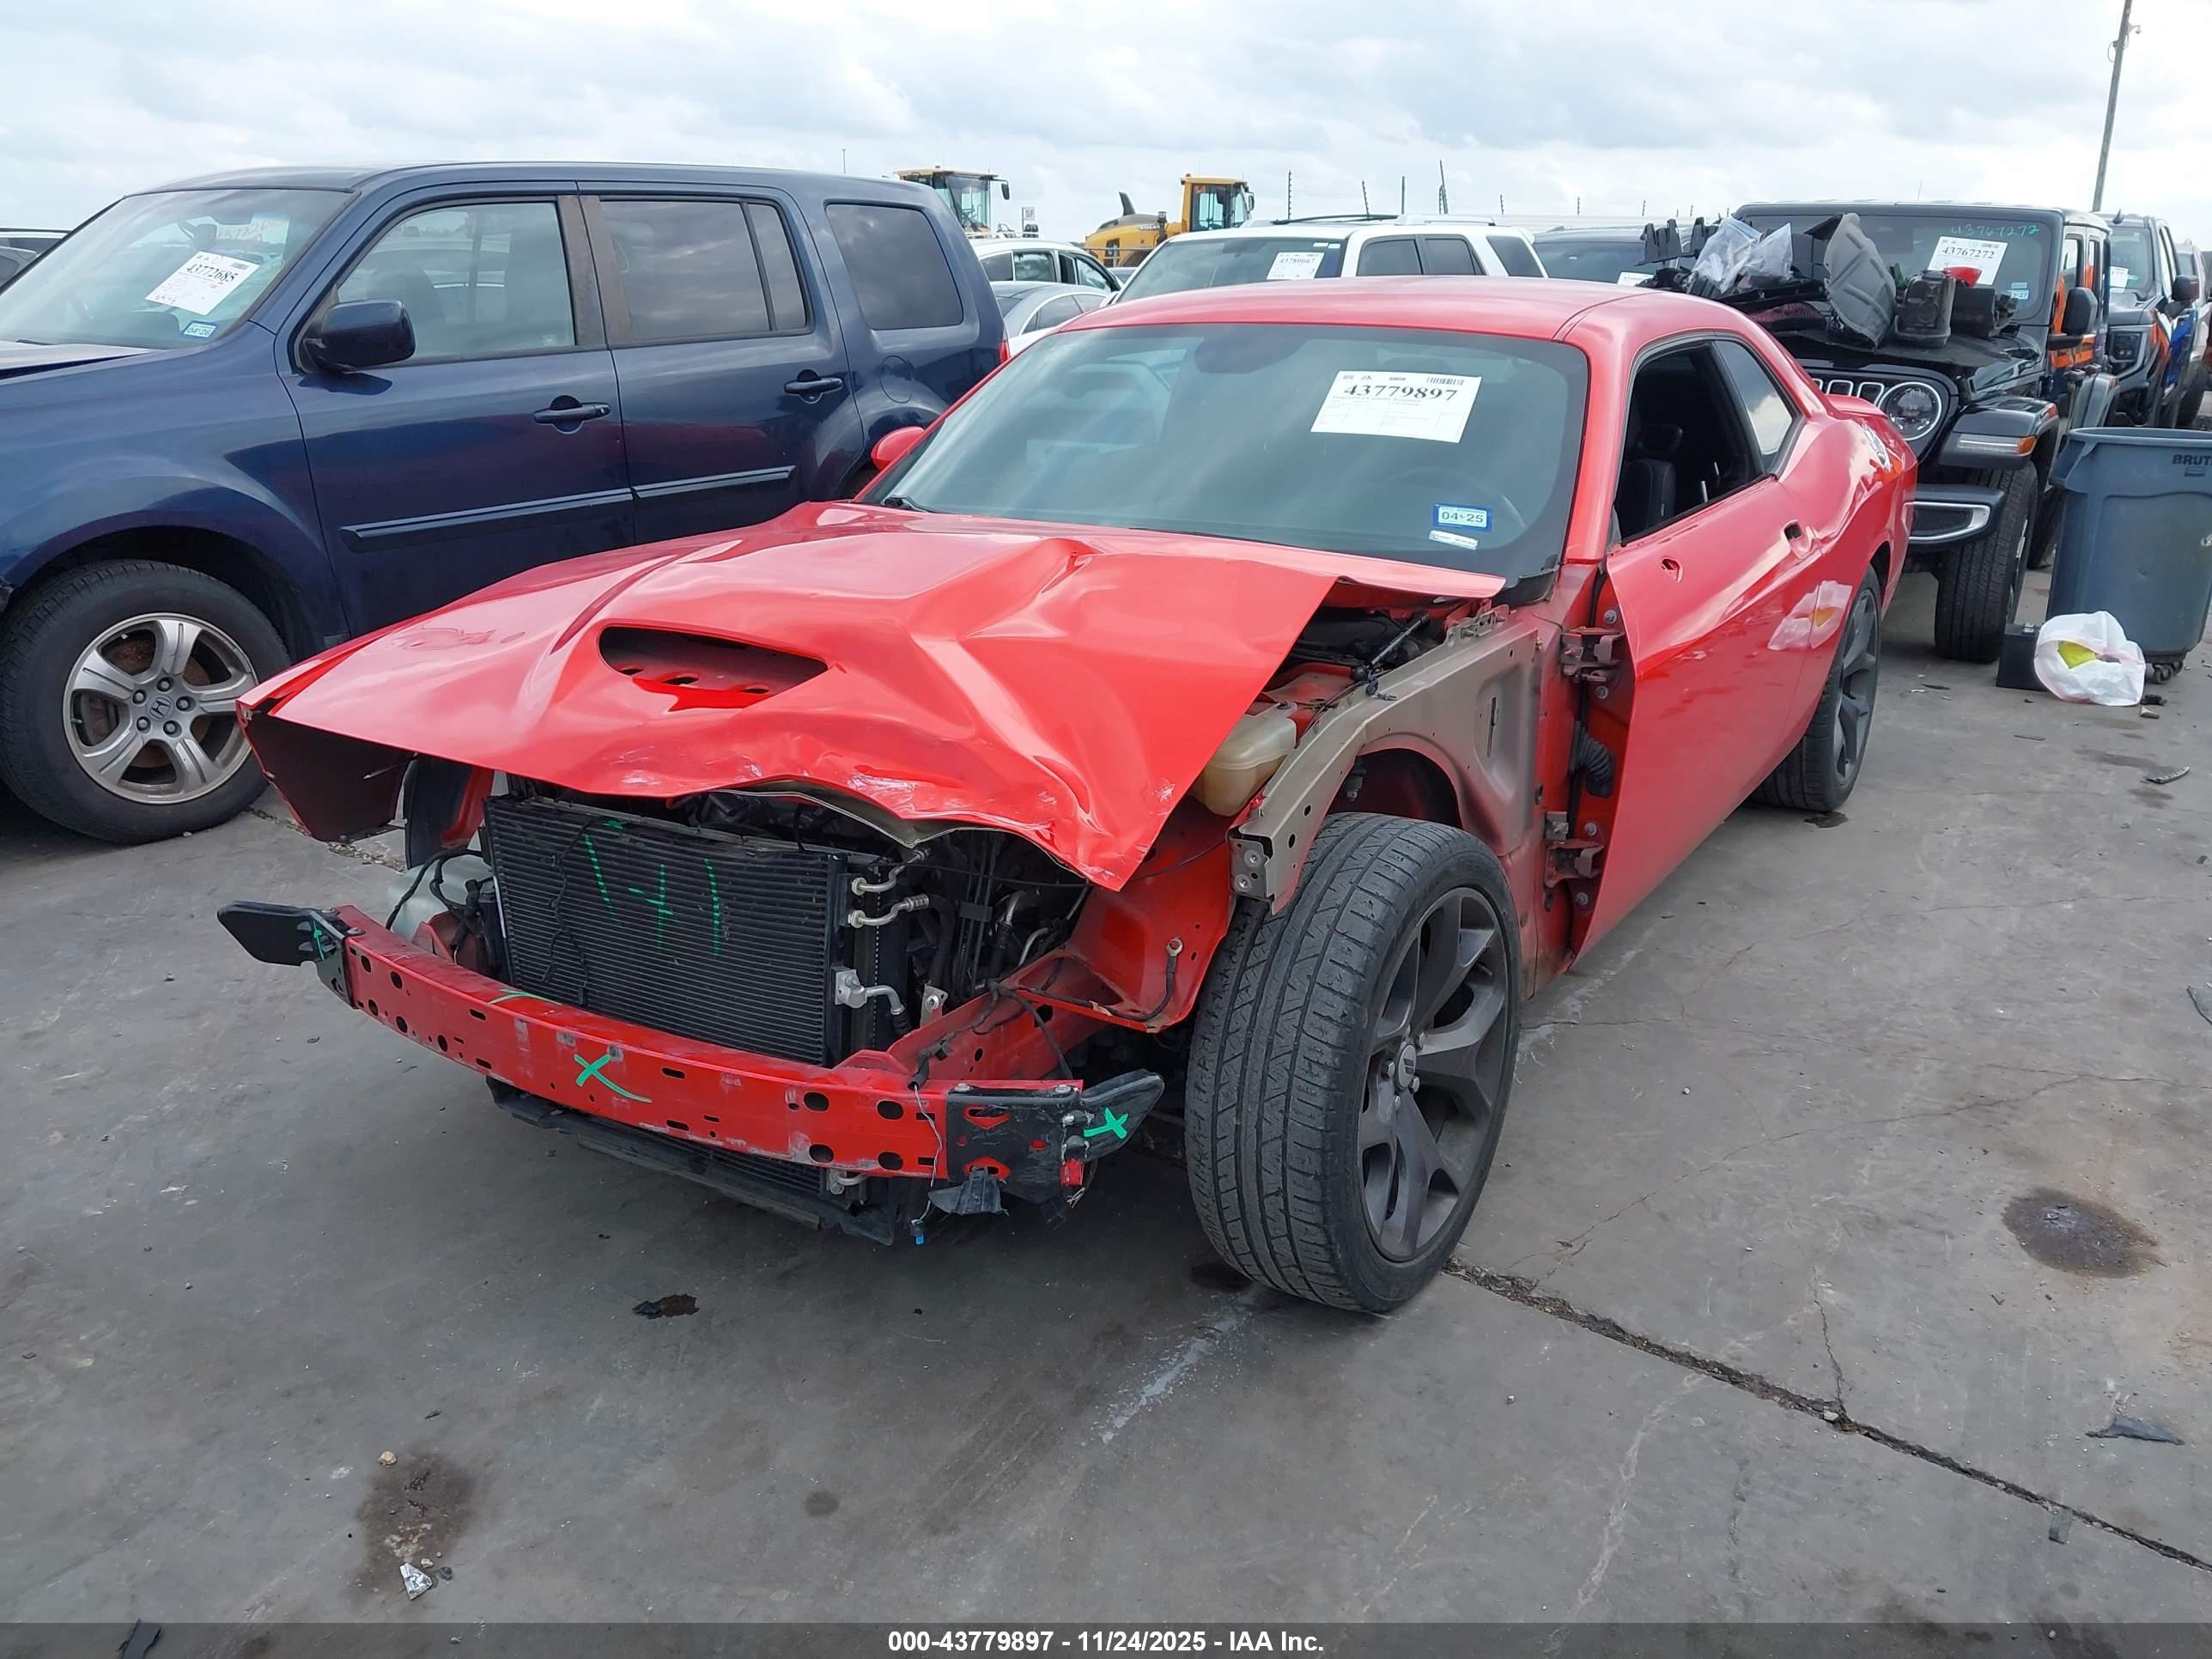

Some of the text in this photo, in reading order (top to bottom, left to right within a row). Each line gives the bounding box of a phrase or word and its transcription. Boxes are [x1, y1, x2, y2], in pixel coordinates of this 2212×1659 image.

[1942, 246, 1996, 259] 43767272
[186, 263, 239, 283] 43772685
[1344, 384, 1458, 402] 43779897
[2172, 454, 2212, 465] BRUT
